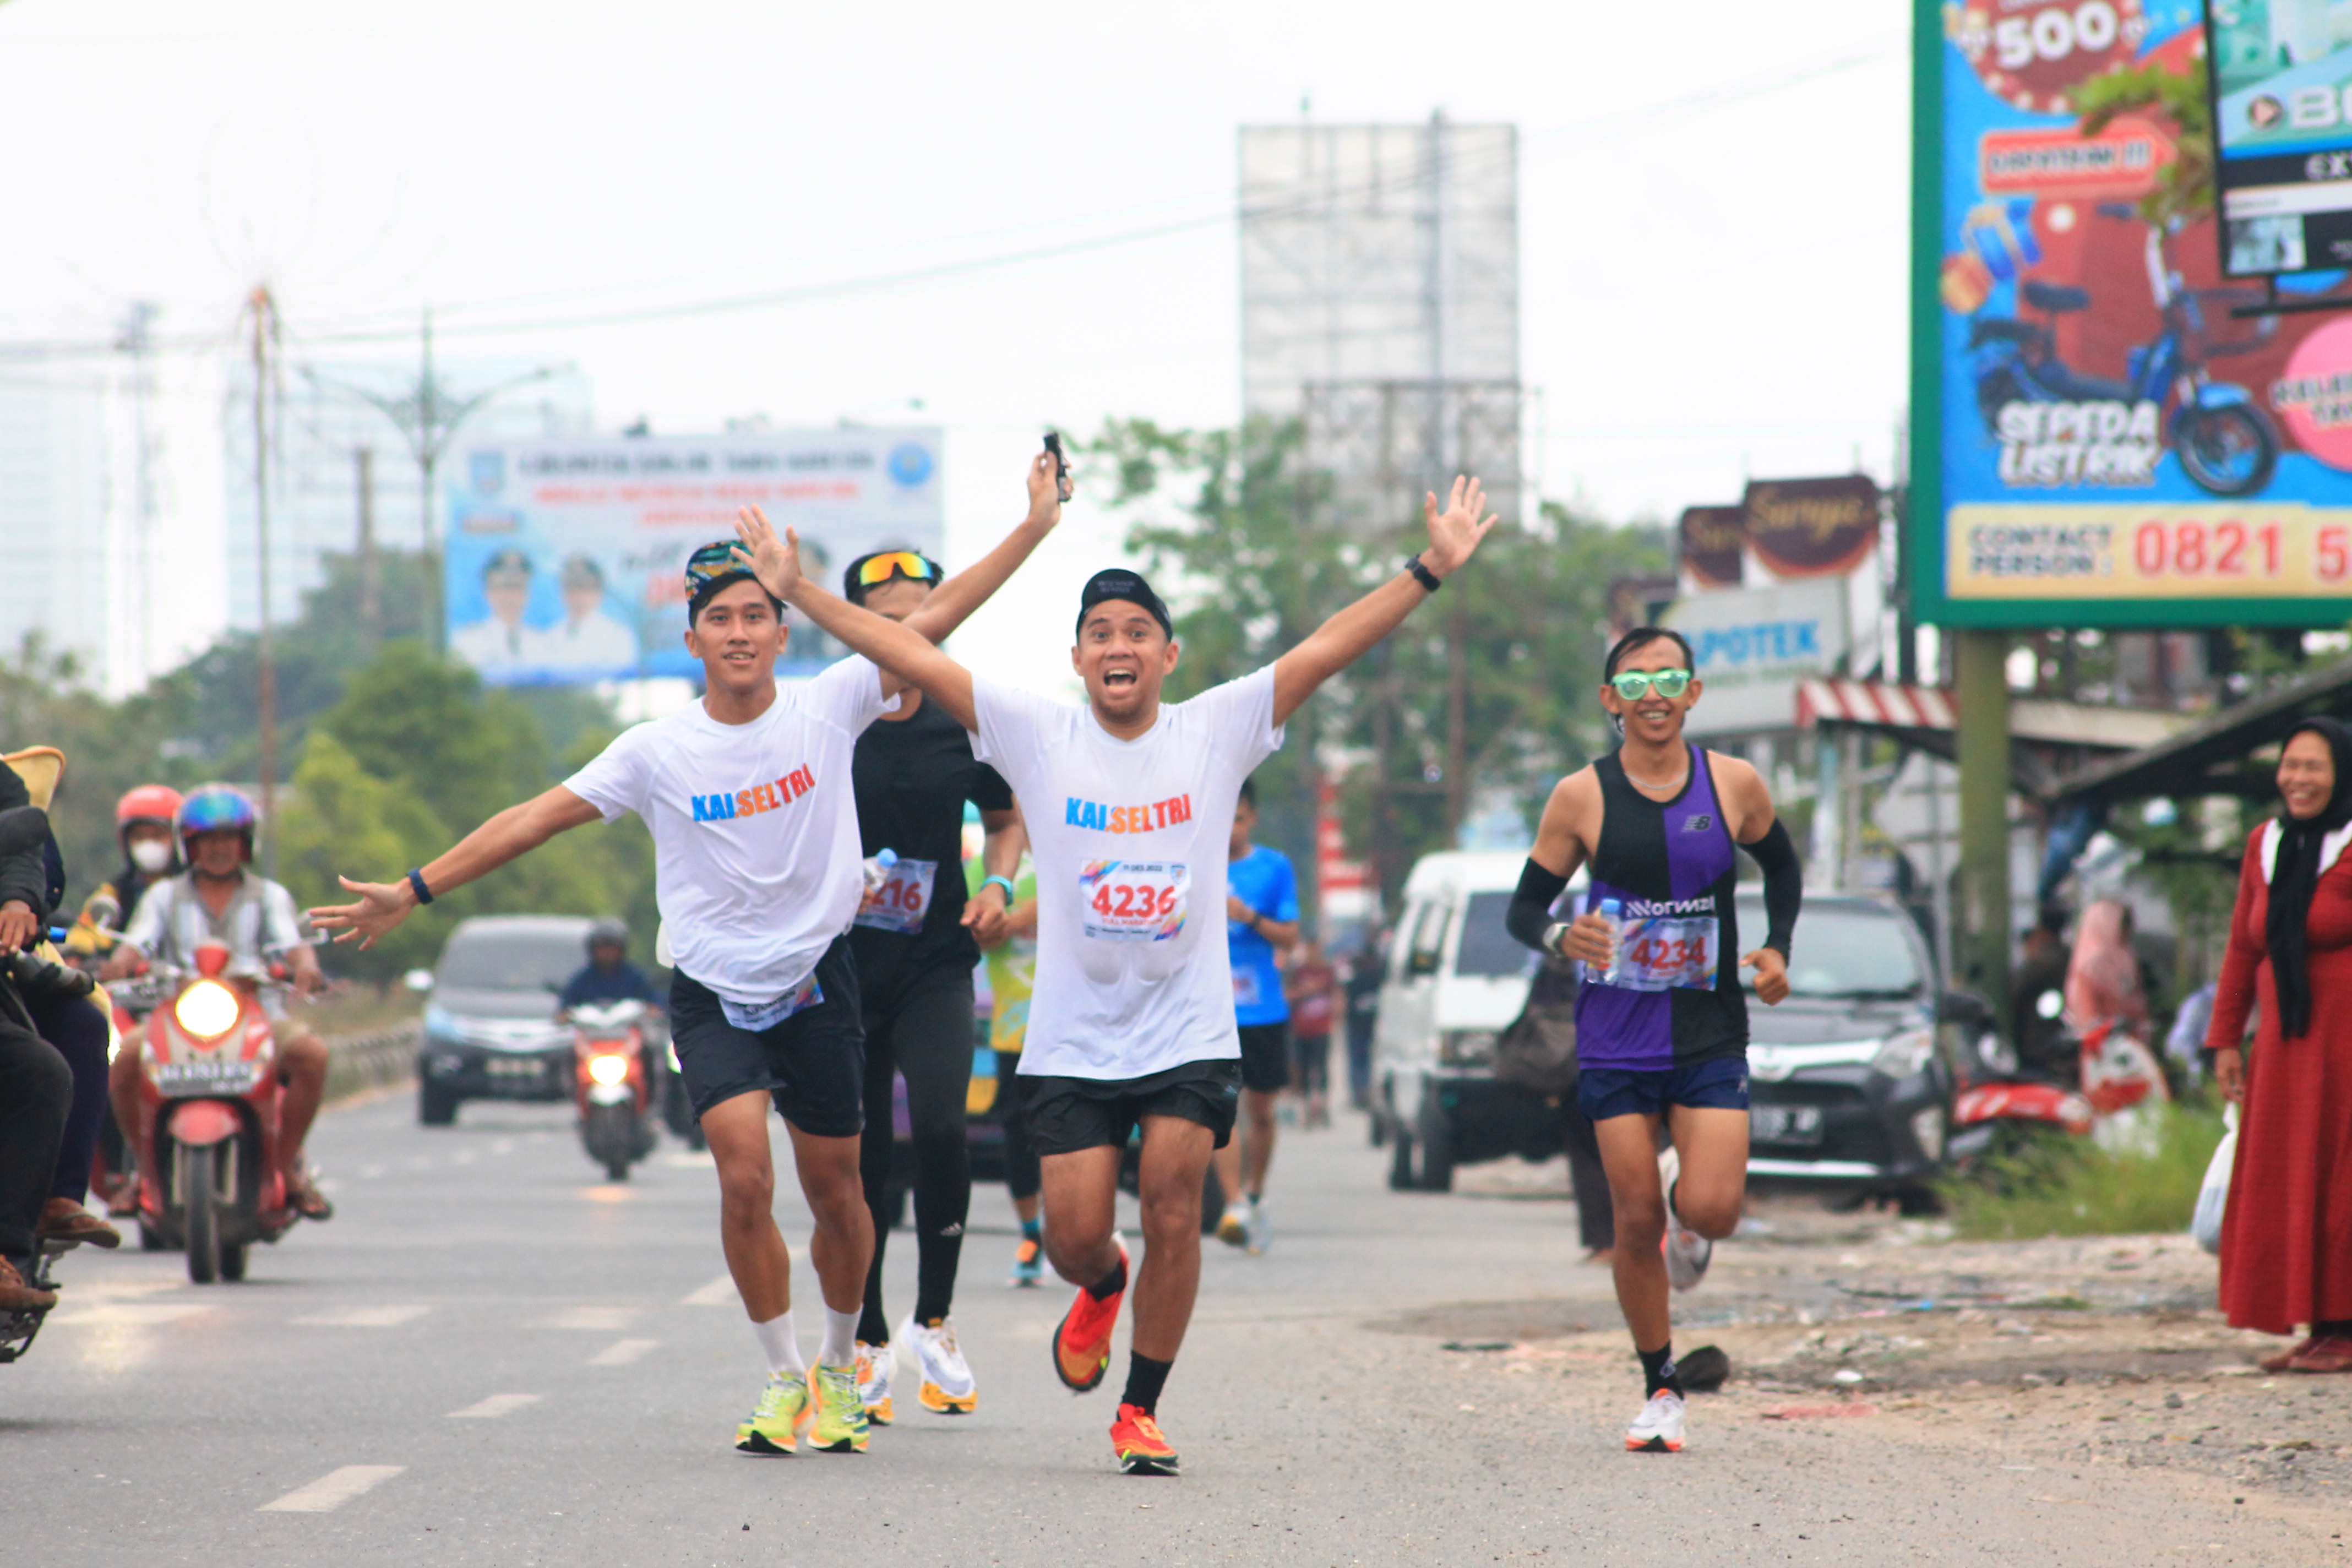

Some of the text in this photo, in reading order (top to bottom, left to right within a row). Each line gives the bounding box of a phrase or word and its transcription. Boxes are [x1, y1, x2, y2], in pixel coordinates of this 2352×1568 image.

[1994, 1, 2118, 70] 500
[1999, 399, 2160, 440] SEPEDA
[1969, 525, 2113, 549] CONTACT
[2136, 520, 2280, 575] 0821
[1971, 552, 2094, 575] PERSON
[1685, 619, 1819, 665] POTEK
[1092, 884, 1177, 918] 4236
[1631, 937, 1706, 970] 4234
